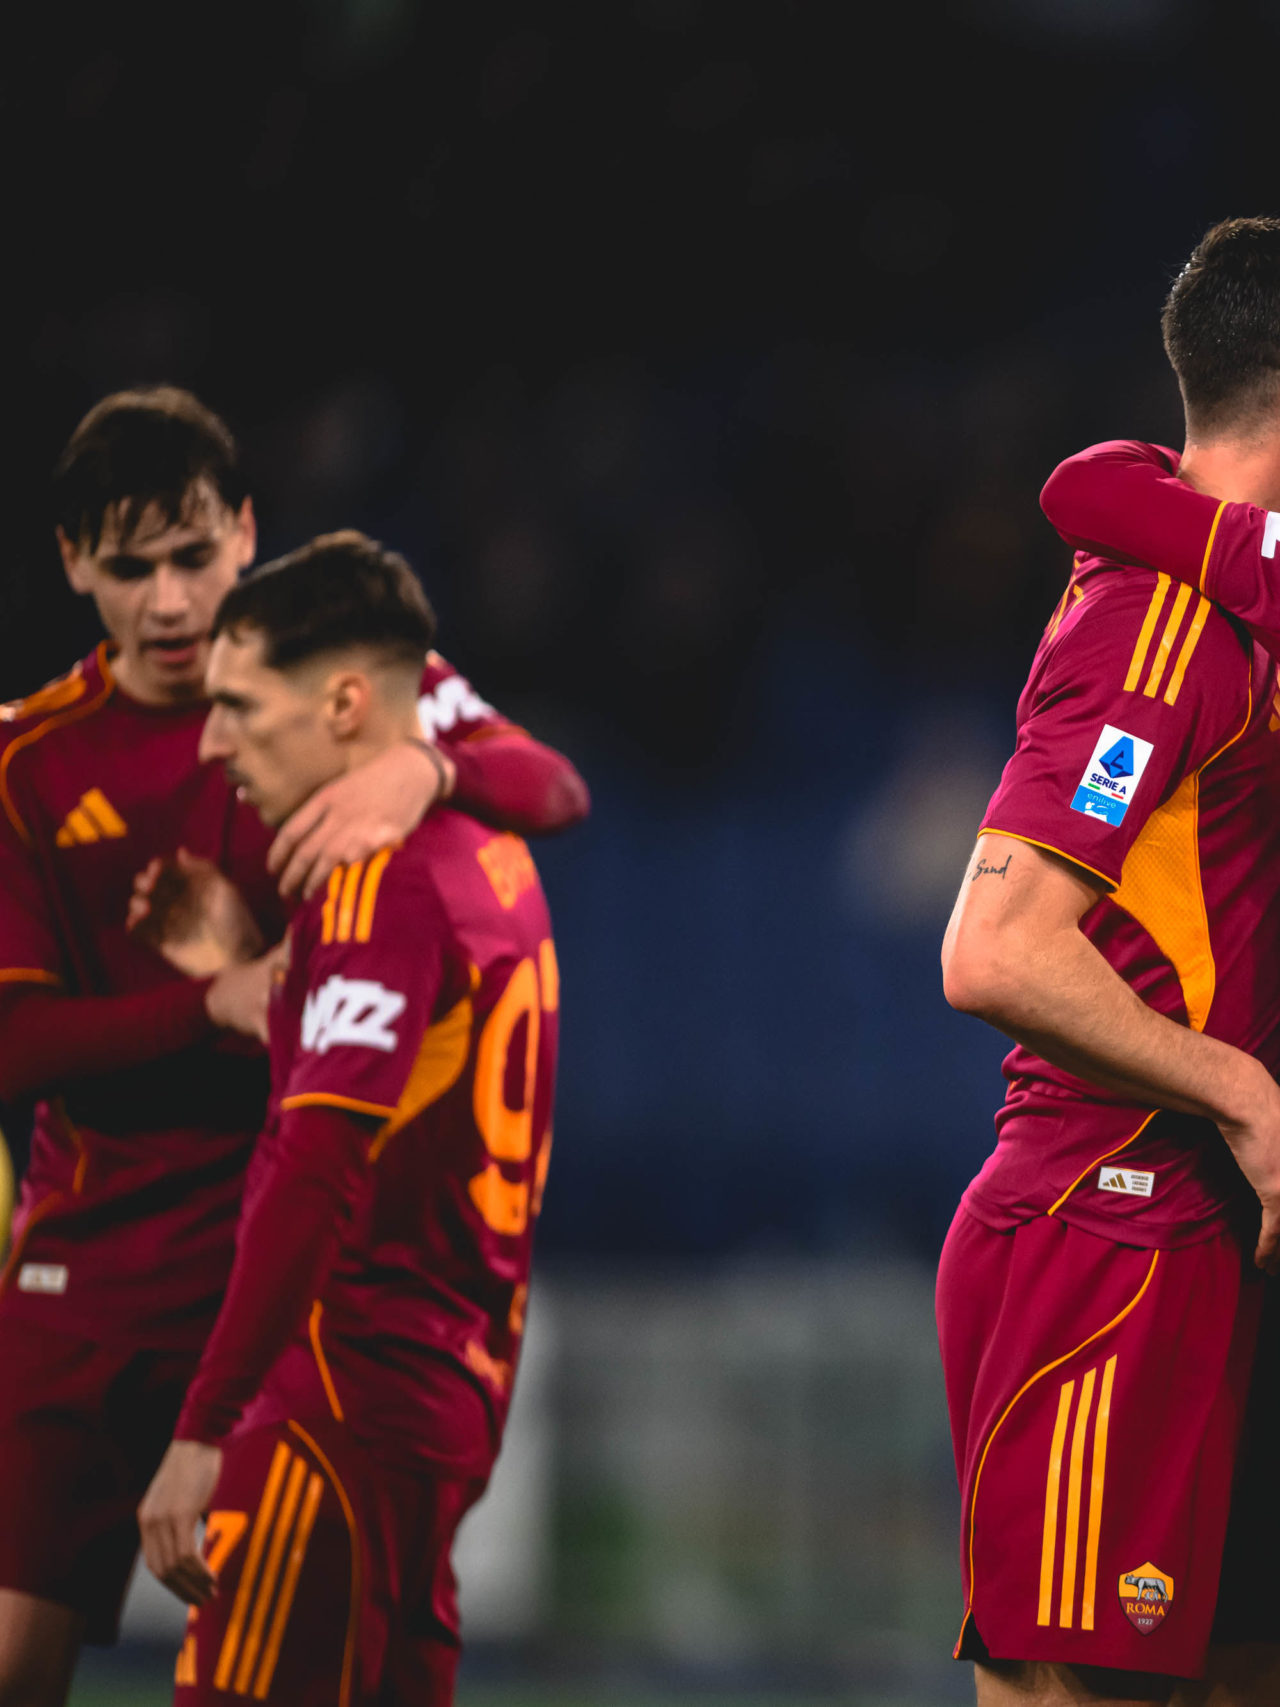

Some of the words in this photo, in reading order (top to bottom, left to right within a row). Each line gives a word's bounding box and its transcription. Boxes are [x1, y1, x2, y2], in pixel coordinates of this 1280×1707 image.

[1090, 772, 1119, 791] SERIE
[1119, 785, 1127, 795] A
[1126, 1602, 1166, 1617] ROMA
[1138, 1617, 1153, 1625] 1927
